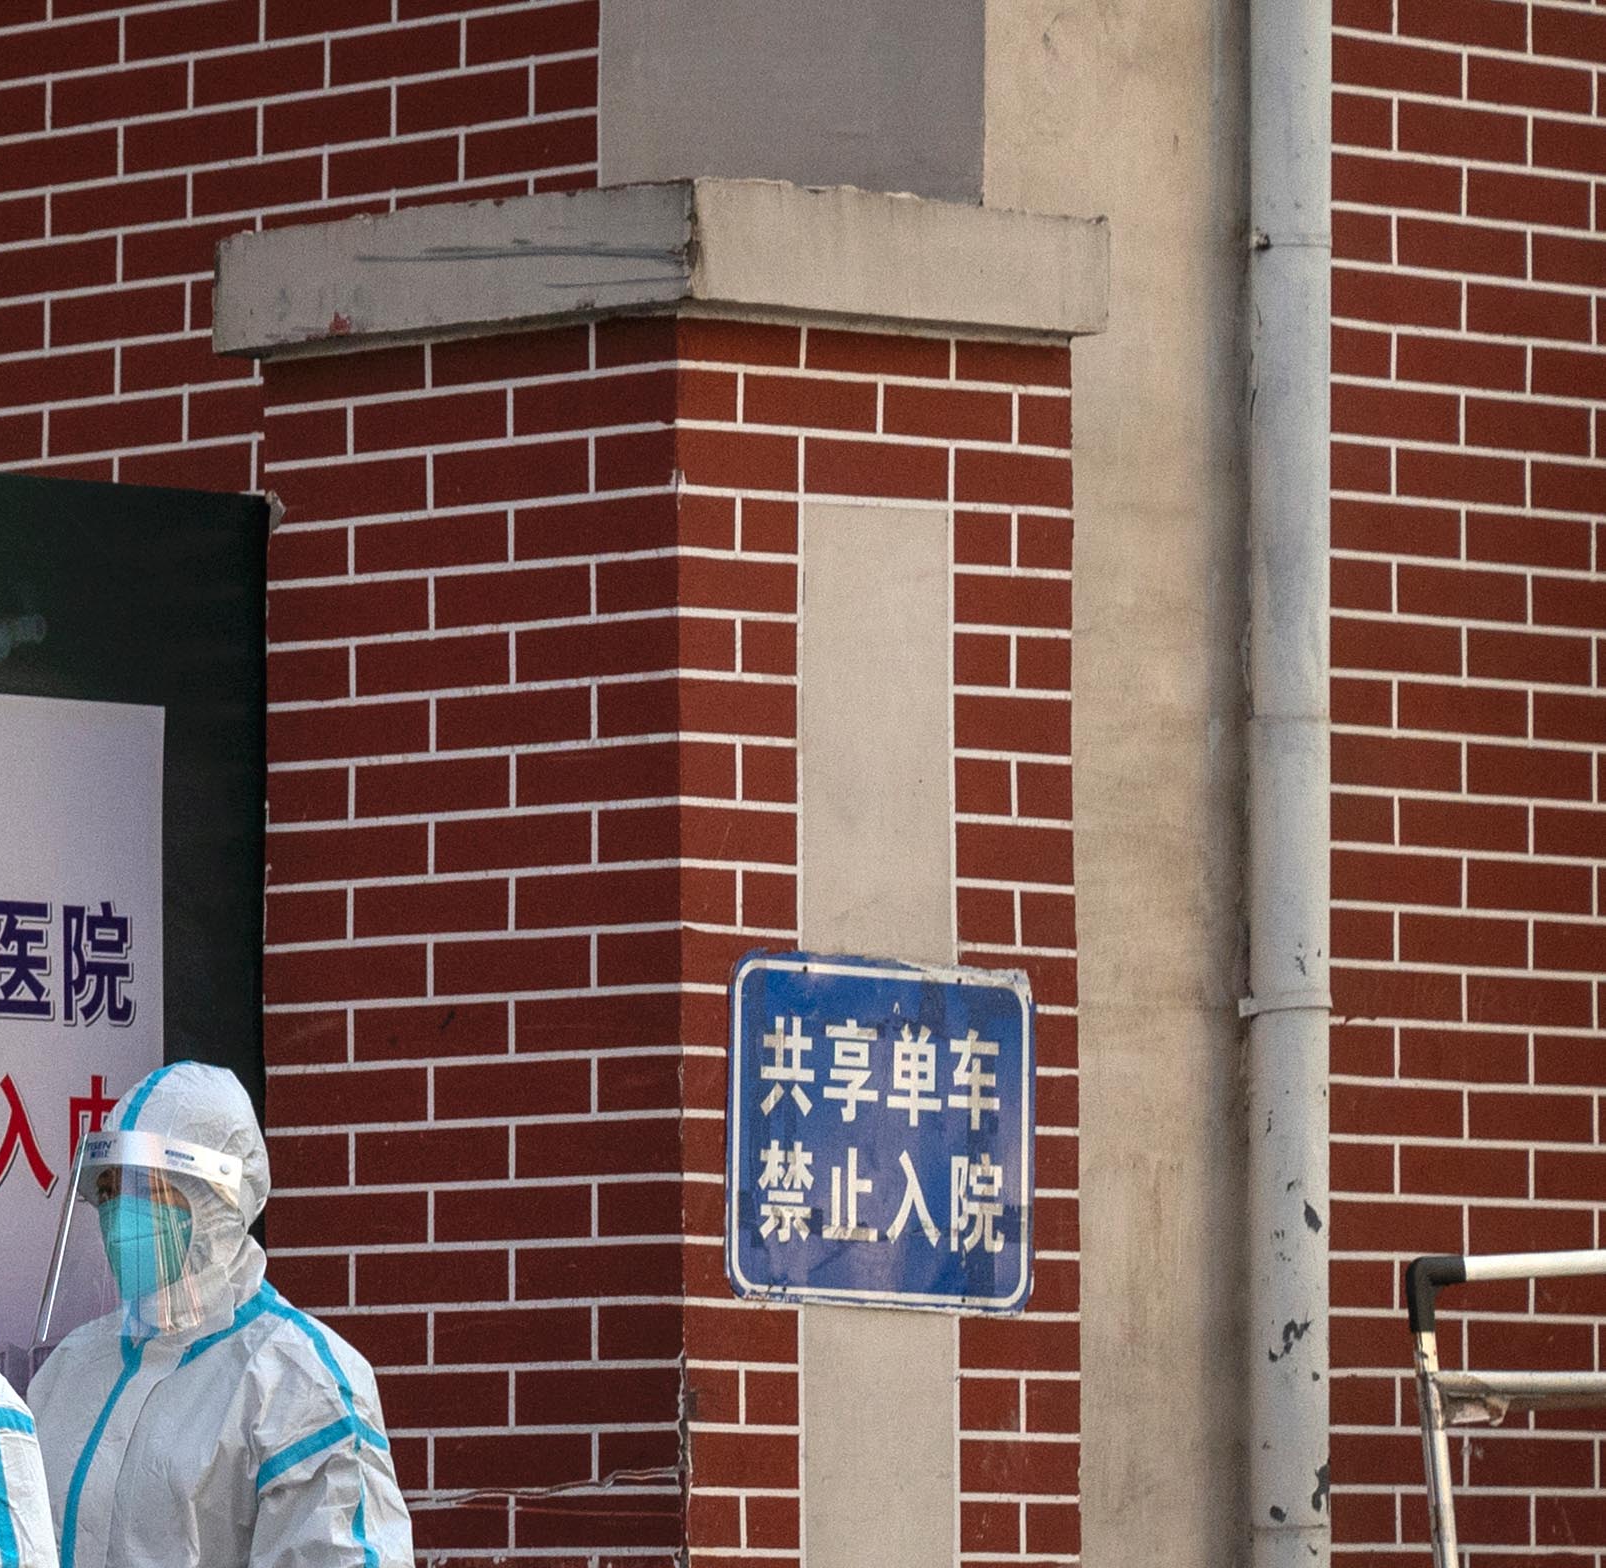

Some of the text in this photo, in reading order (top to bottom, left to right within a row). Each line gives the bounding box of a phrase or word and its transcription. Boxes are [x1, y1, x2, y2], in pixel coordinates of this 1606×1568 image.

[760, 1015, 1000, 1130] 共享单车
[758, 1140, 1005, 1254] 禁止入院
